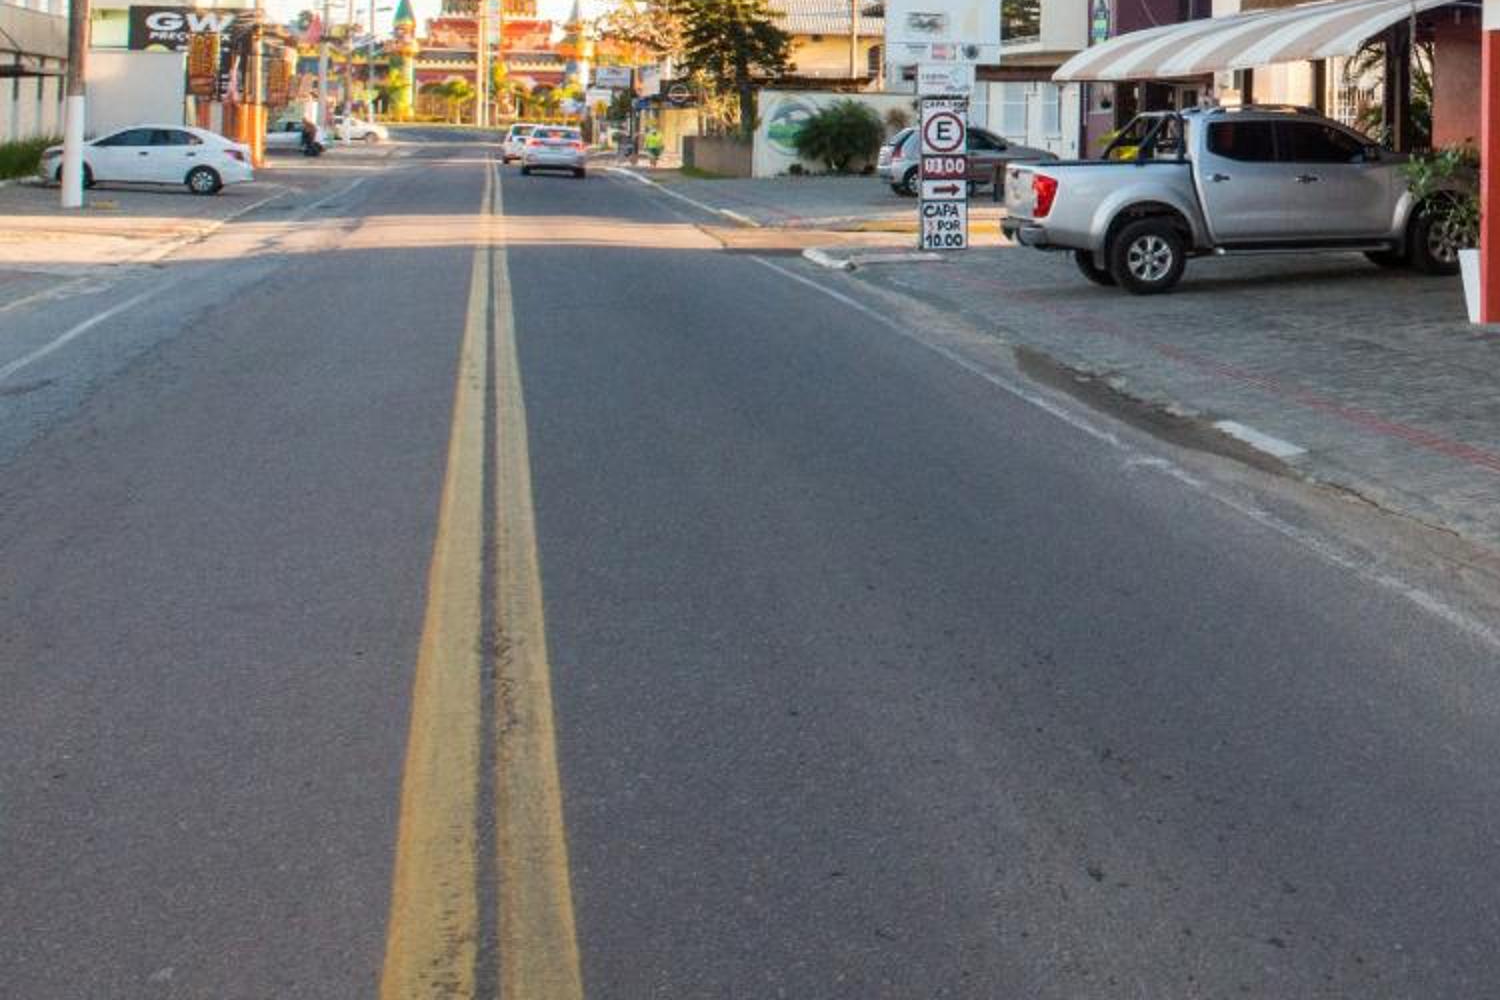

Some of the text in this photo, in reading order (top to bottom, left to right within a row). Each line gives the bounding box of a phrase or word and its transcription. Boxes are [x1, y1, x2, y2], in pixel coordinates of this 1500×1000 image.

[937, 121, 952, 140] E
[923, 203, 960, 217] CAPA
[938, 220, 960, 231] POR
